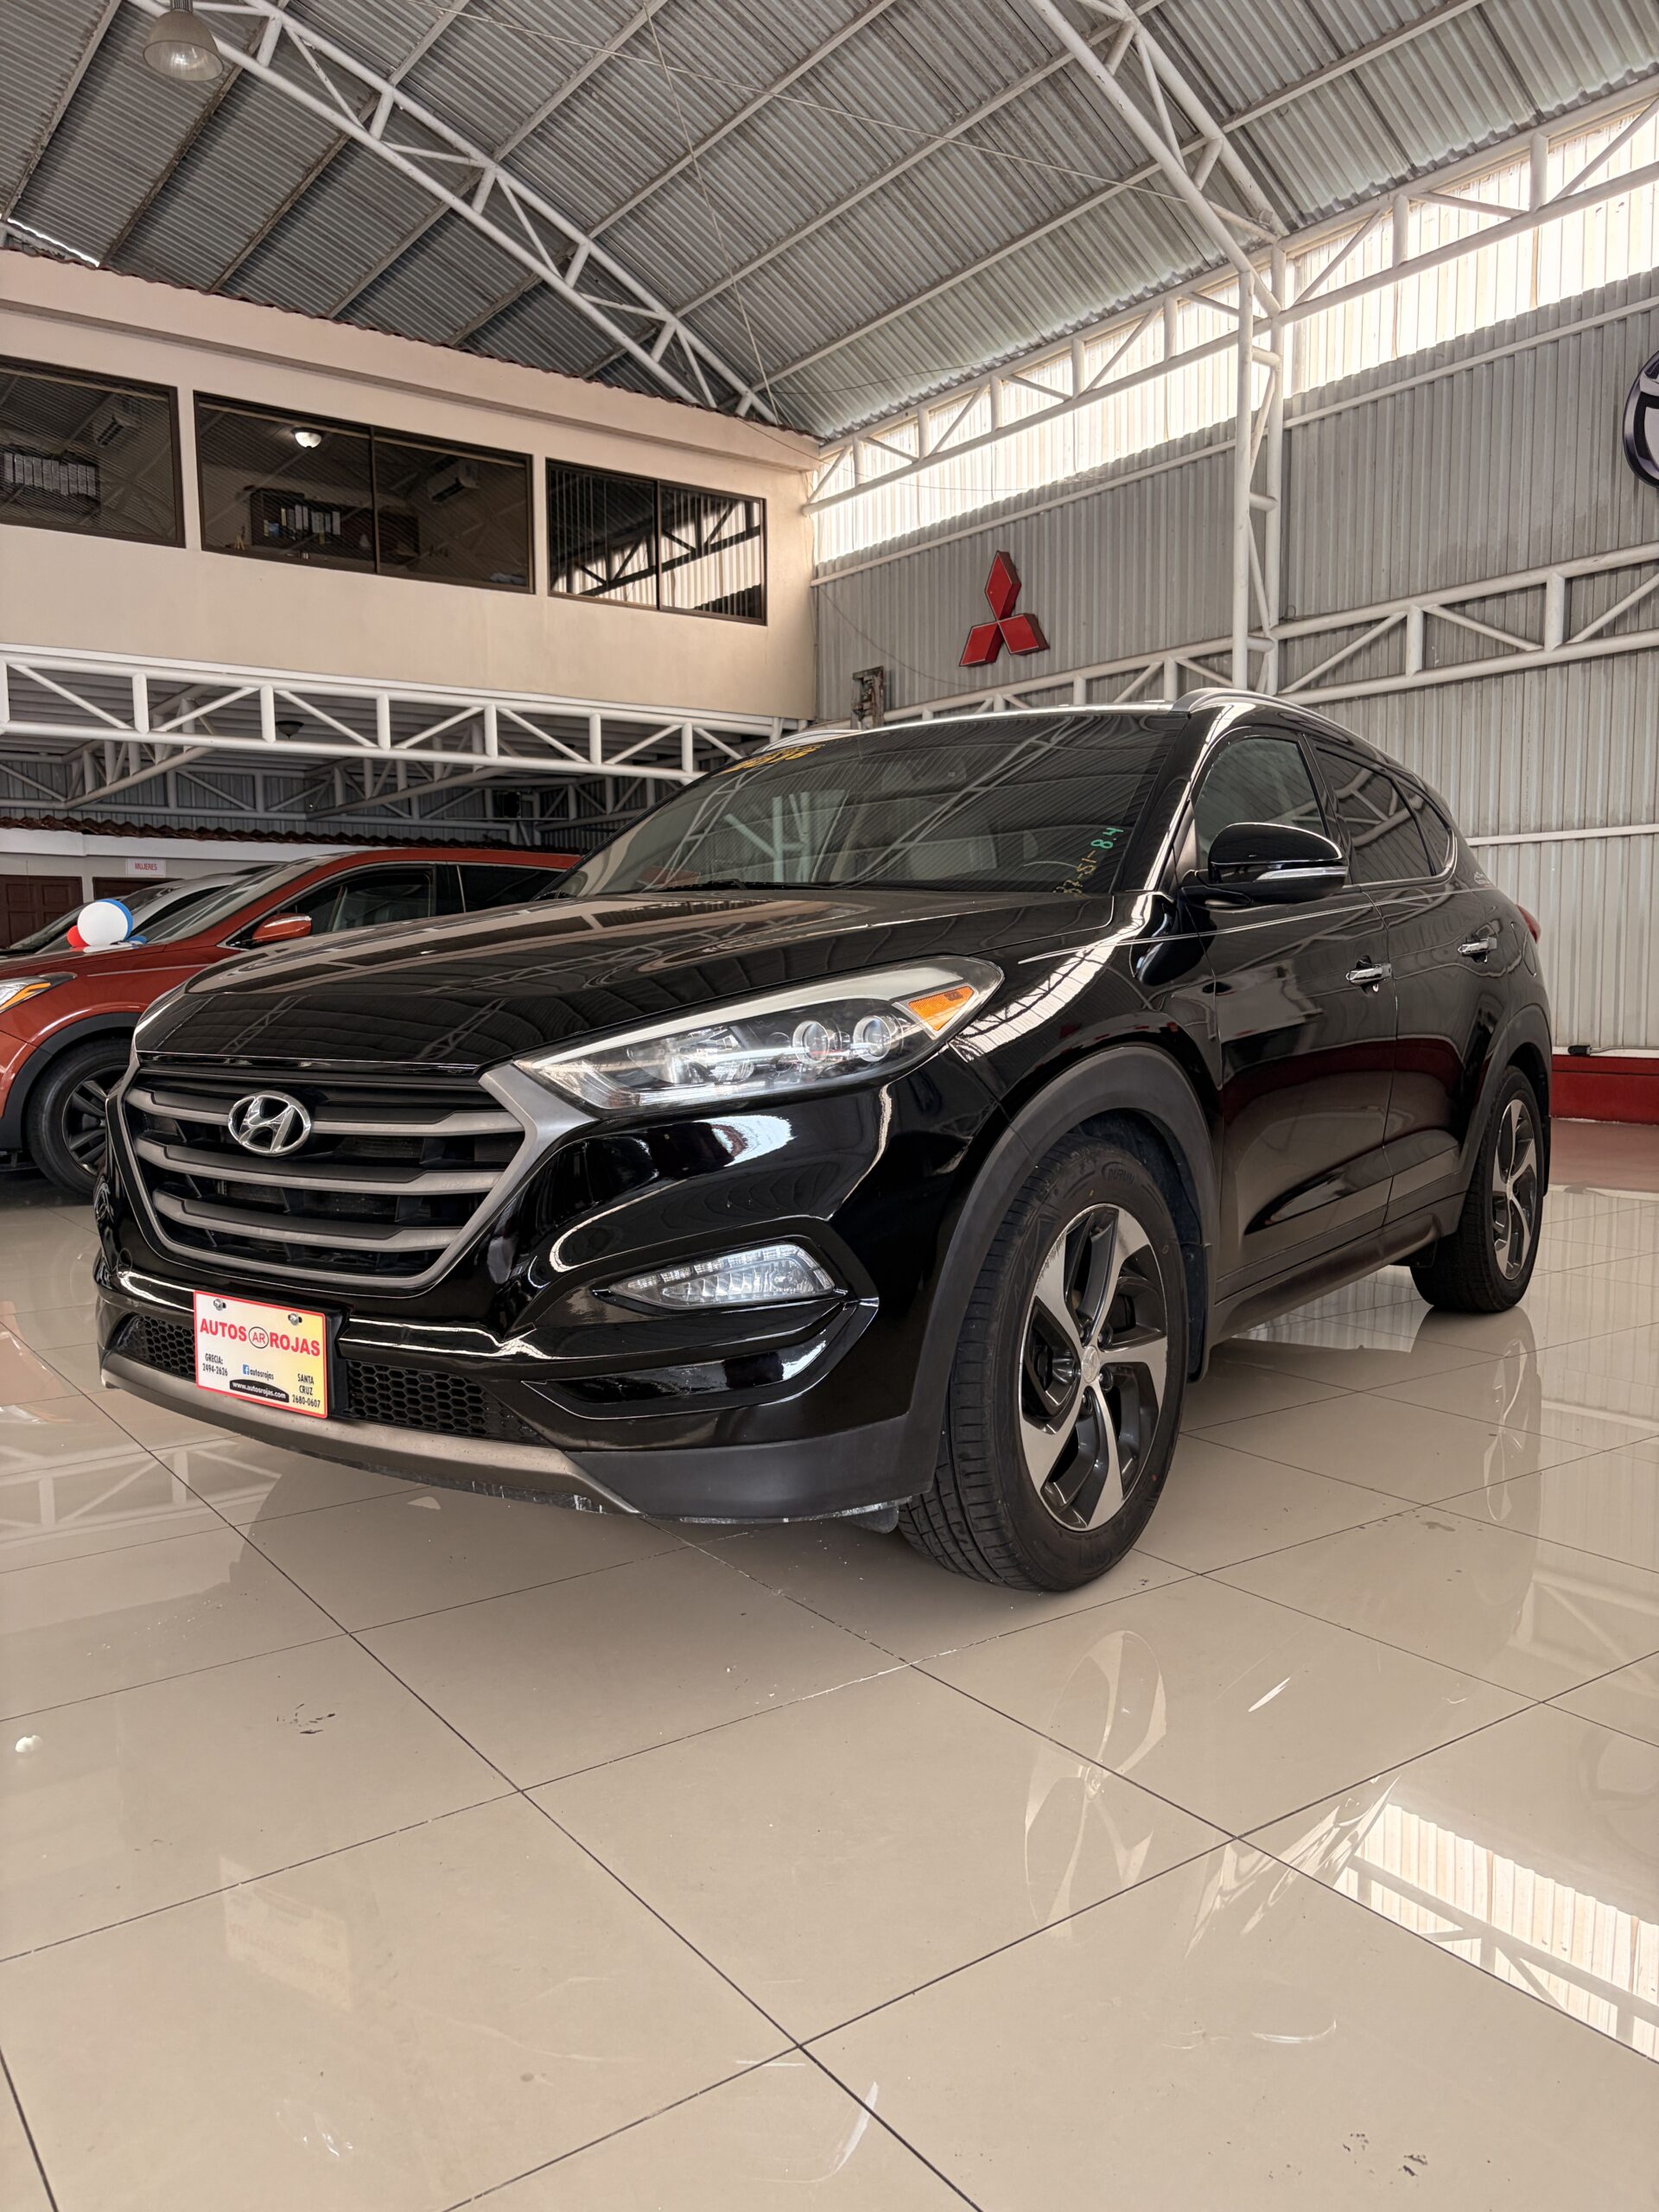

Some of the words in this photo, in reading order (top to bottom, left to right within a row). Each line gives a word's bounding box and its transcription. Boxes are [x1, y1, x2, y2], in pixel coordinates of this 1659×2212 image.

[135, 862, 157, 871] MUJERES
[200, 1318, 247, 1342] AUTOS
[252, 1332, 265, 1344] AR
[270, 1332, 321, 1357] ROJAS
[205, 1353, 223, 1364] GRECIA:
[202, 1363, 228, 1376] 2494-2626
[250, 1369, 274, 1381] autosrojas
[297, 1373, 315, 1384] SANTA
[232, 1382, 286, 1399] www.autosrojas.com
[299, 1385, 313, 1395] CRUZ
[292, 1395, 321, 1408] 2680-0607
